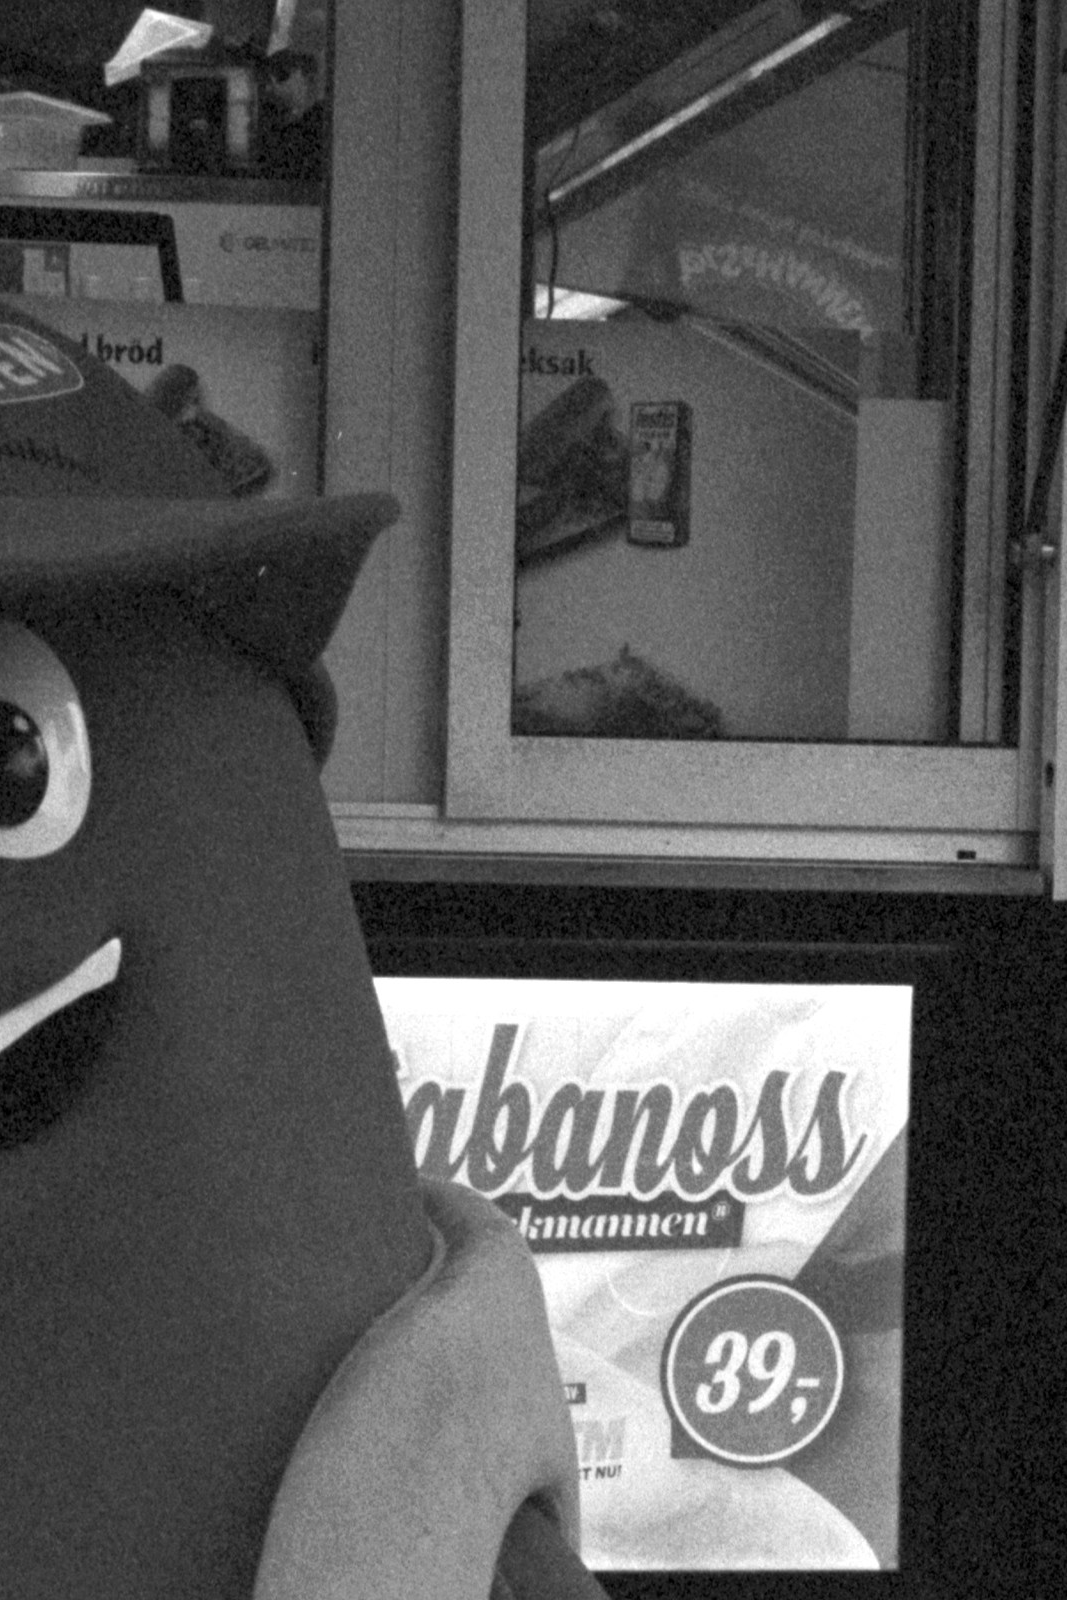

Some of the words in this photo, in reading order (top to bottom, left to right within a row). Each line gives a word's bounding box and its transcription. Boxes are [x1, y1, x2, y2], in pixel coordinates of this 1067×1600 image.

[97, 335, 163, 365] bröd
[404, 1023, 867, 1196] abanoss
[511, 1206, 709, 1240] kmannen
